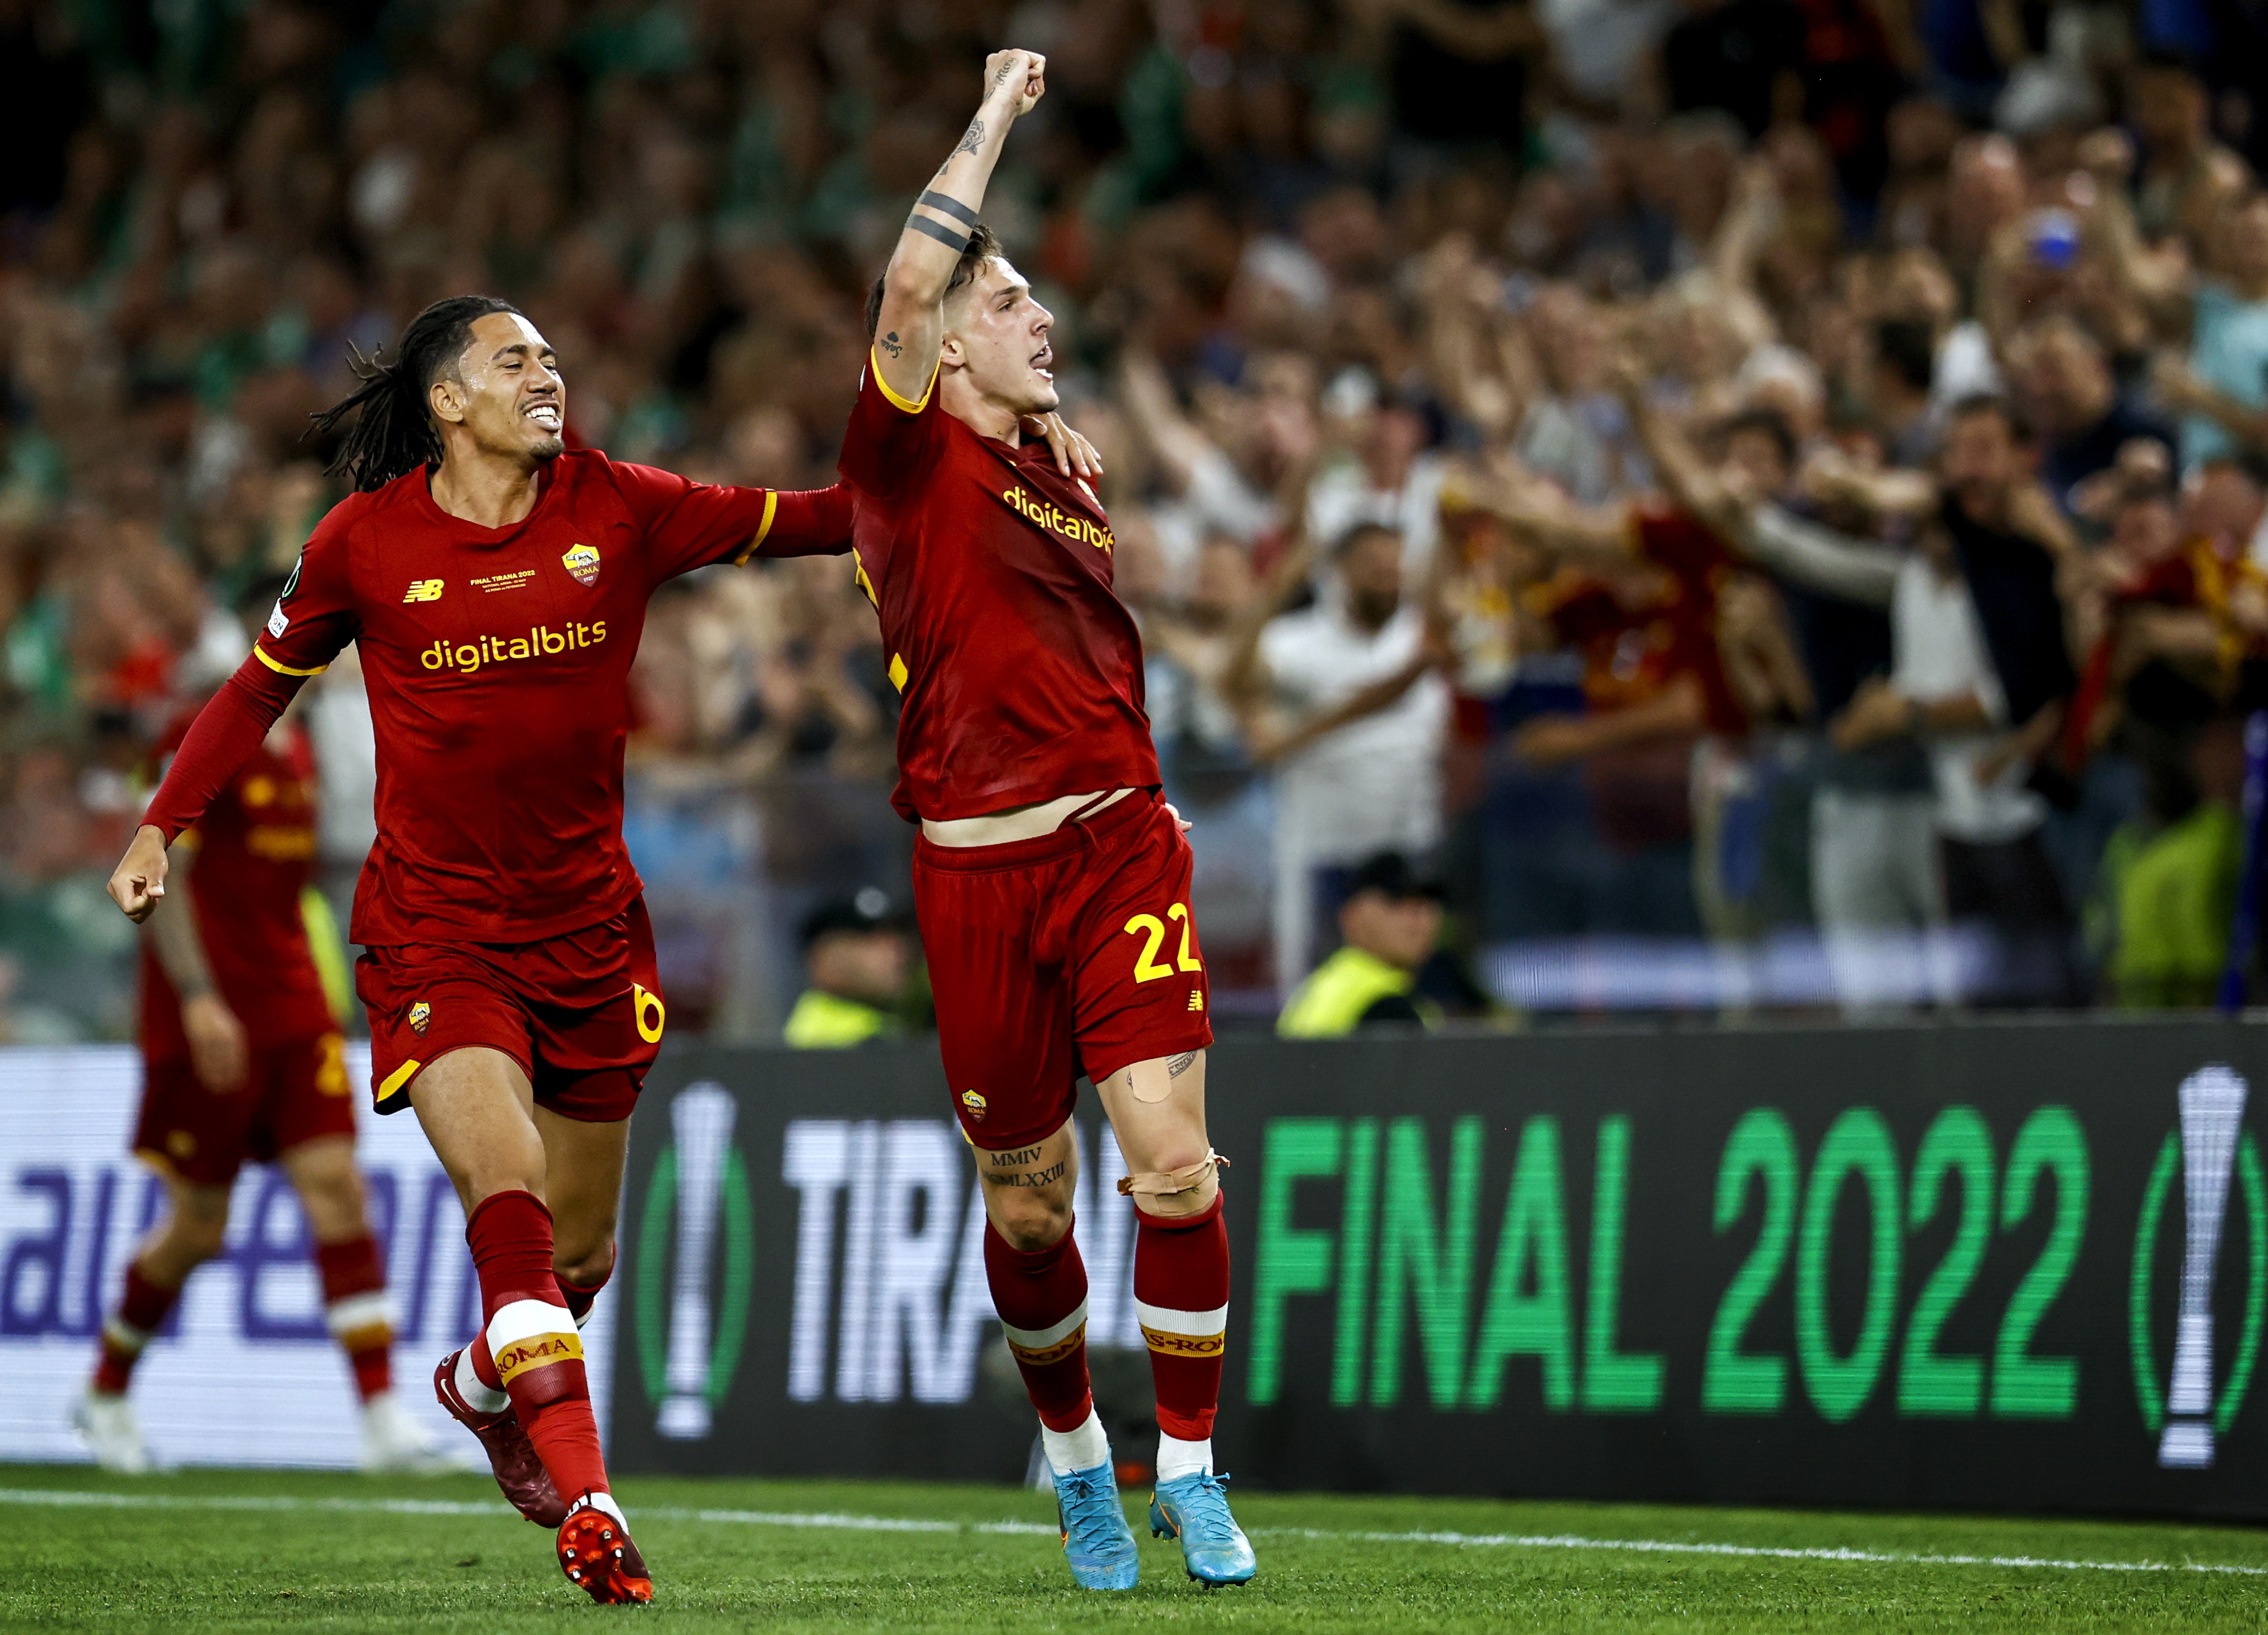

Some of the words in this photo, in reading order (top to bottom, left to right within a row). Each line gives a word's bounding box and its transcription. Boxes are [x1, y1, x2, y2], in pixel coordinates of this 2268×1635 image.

[470, 578, 492, 586] FINAL
[491, 573, 518, 582] TIRANA
[518, 570, 535, 578] 2022
[573, 566, 599, 578] ROMA
[421, 621, 606, 673] digitalbits
[1124, 902, 1202, 984] 22
[414, 1018, 429, 1030] ROMA
[631, 982, 665, 1043] 6
[991, 1146, 1041, 1166] MMIV
[1246, 1114, 1667, 1412] FINAL
[1701, 1104, 2091, 1424] 2022
[497, 1338, 570, 1380] ROMA
